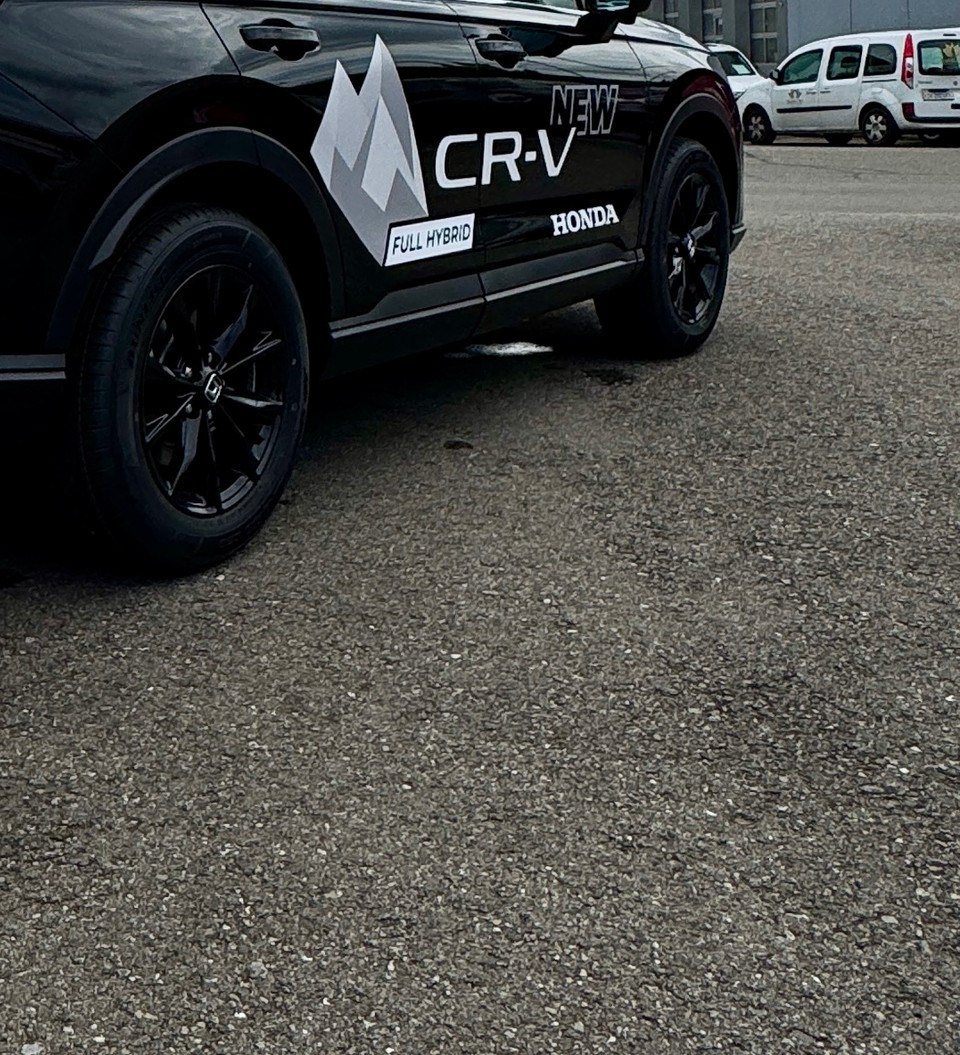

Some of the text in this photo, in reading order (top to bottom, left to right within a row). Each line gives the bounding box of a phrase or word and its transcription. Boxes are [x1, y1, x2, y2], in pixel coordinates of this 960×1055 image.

[549, 84, 620, 136] NEW
[435, 126, 578, 189] CR-V
[392, 222, 472, 256] FULL HYBRID
[550, 203, 620, 237] HONDA
